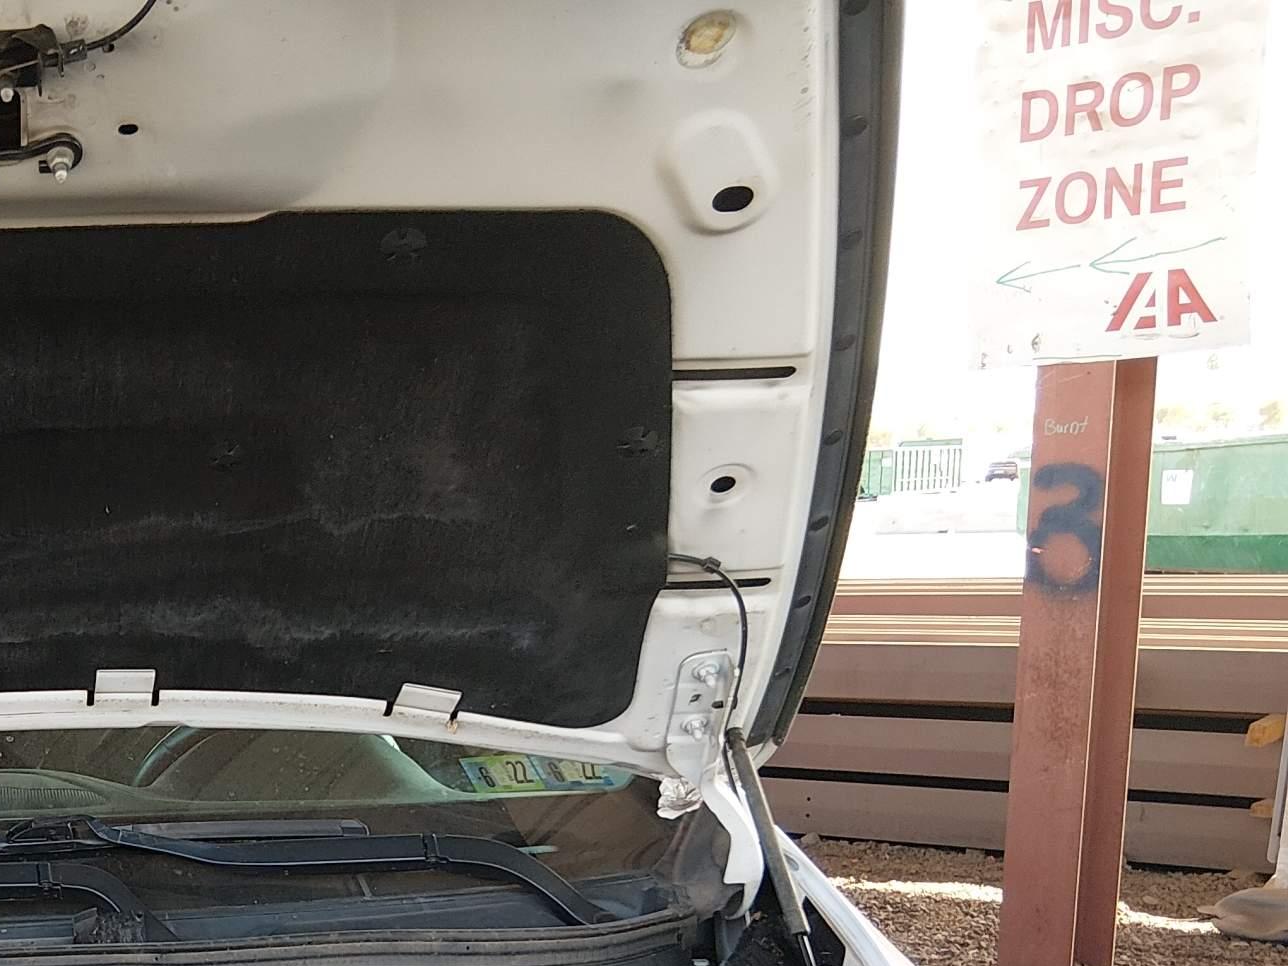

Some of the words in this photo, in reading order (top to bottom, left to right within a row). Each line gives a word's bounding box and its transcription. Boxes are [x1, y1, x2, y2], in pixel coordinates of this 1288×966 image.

[1027, 0, 1201, 54] MISC.
[1019, 63, 1201, 144] DROP
[1015, 155, 1189, 231] ZONE
